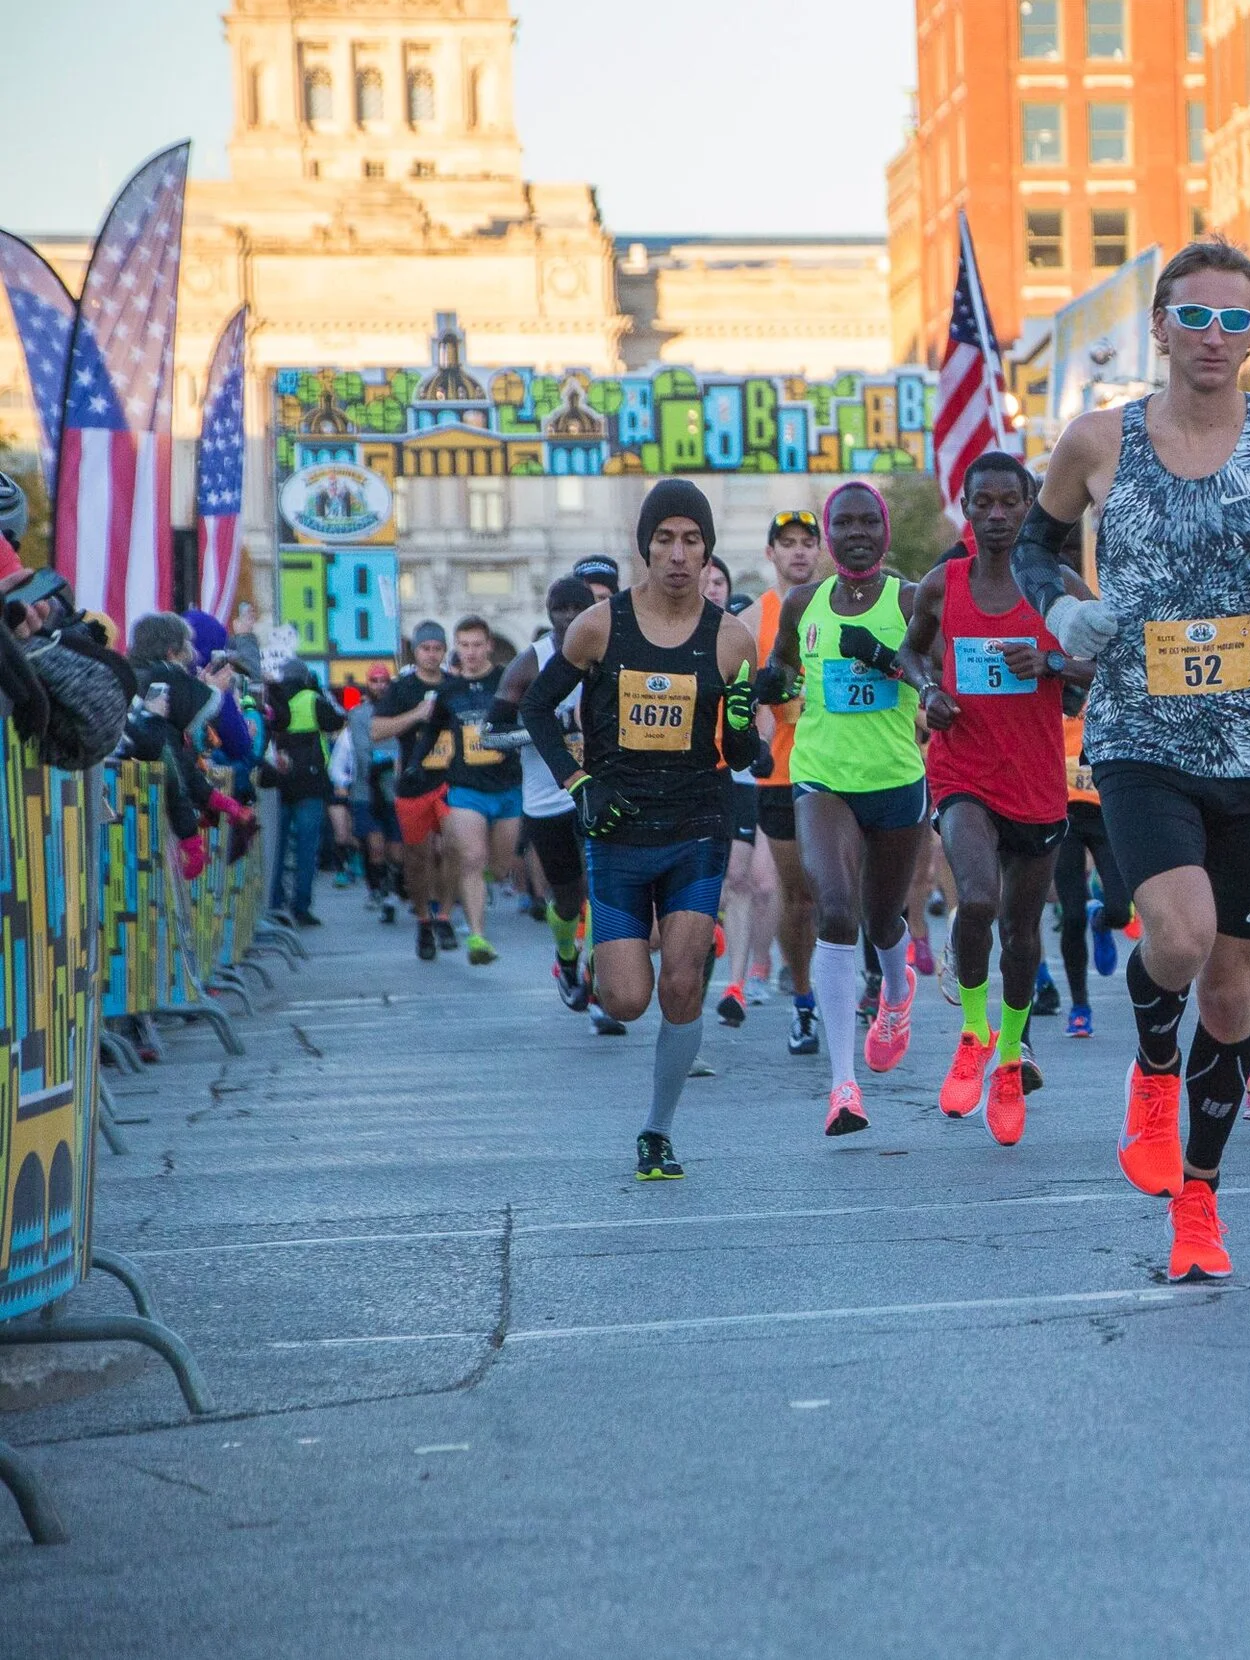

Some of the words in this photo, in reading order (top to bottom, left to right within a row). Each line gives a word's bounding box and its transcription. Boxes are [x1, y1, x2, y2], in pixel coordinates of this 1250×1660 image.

[989, 665, 1001, 688] 5
[1184, 655, 1222, 687] 52
[848, 684, 875, 706] 26
[629, 703, 683, 727] 4678
